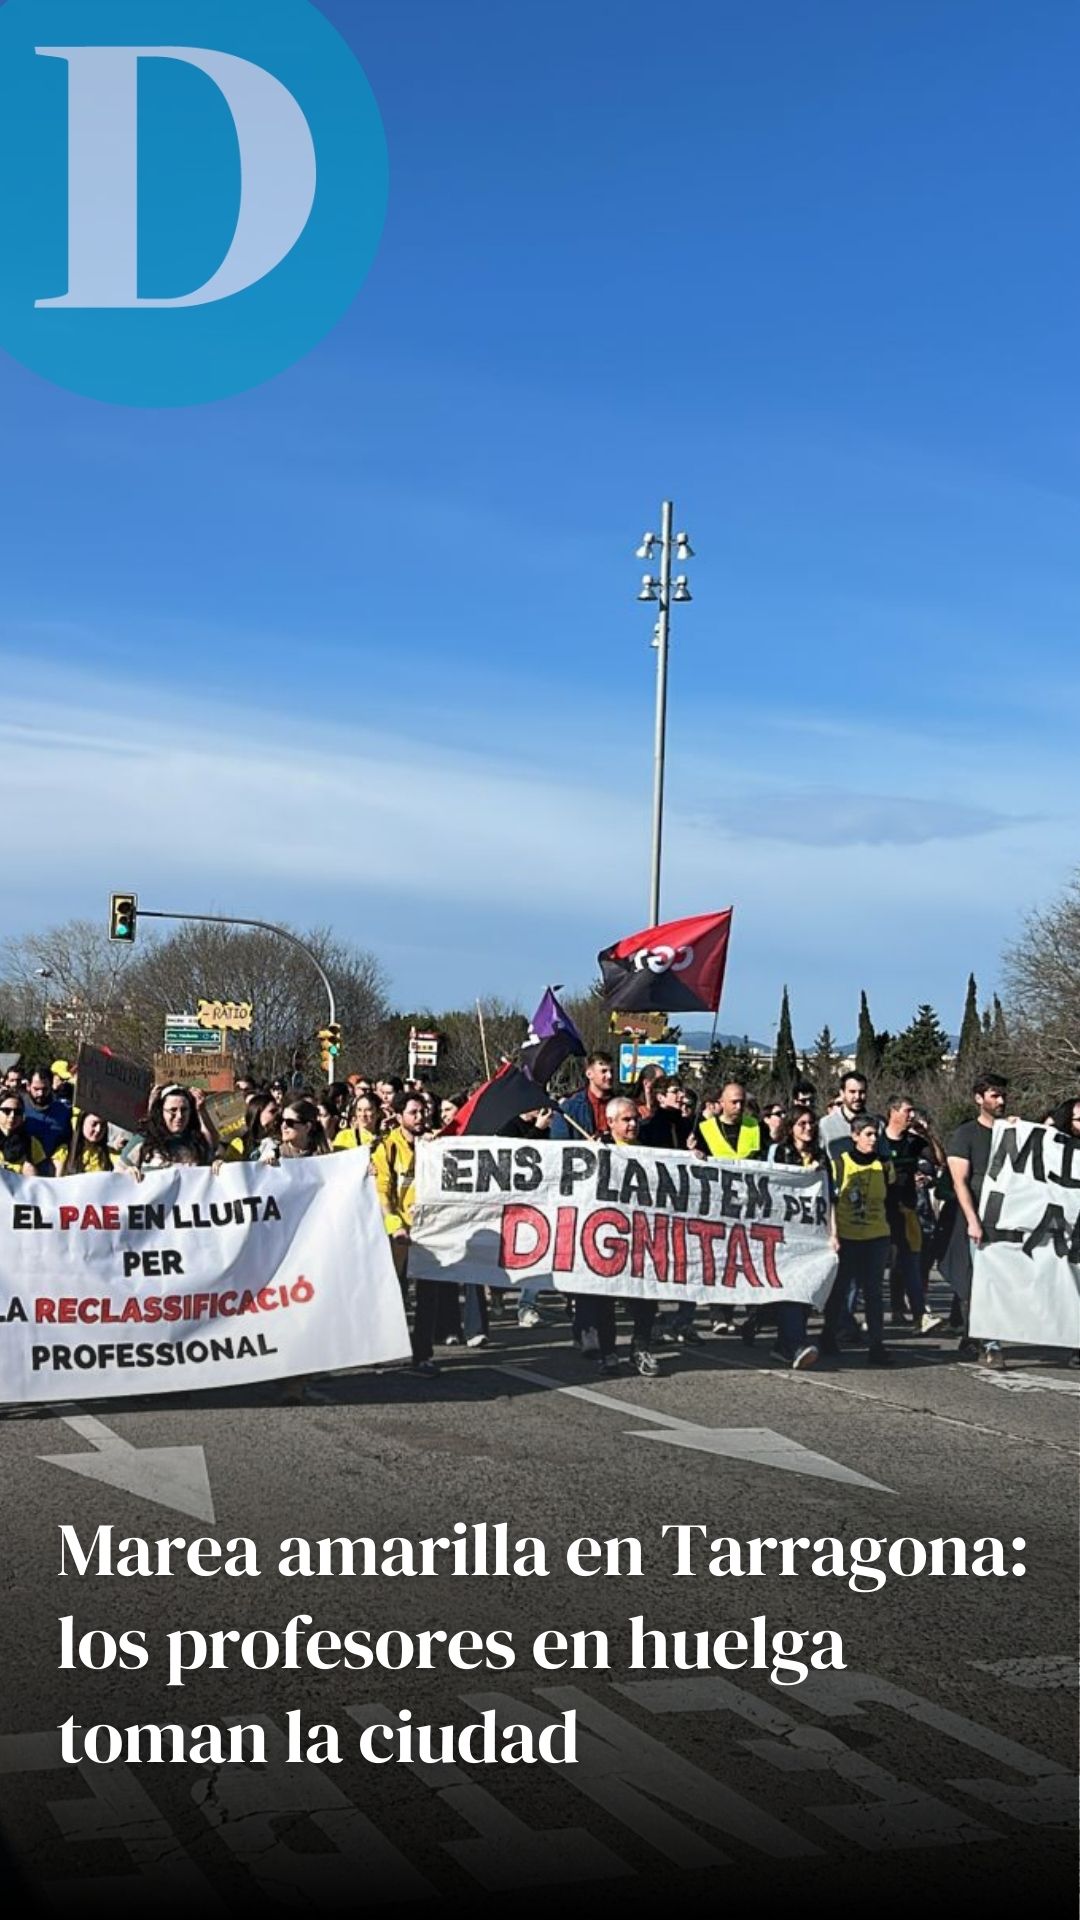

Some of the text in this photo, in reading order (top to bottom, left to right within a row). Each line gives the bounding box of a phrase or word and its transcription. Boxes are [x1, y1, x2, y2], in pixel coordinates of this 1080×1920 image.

[213, 1007, 248, 1020] RATIO
[441, 1145, 828, 1226] ENS PLANTEM PER
[13, 1196, 282, 1230] EL PAE EN LLUITA
[123, 1250, 184, 1277] PER
[500, 1203, 786, 1290] DIGNITAT
[35, 1275, 315, 1324] RECLASSIFICACIÓ
[32, 1333, 278, 1371] PROFESSIONAL
